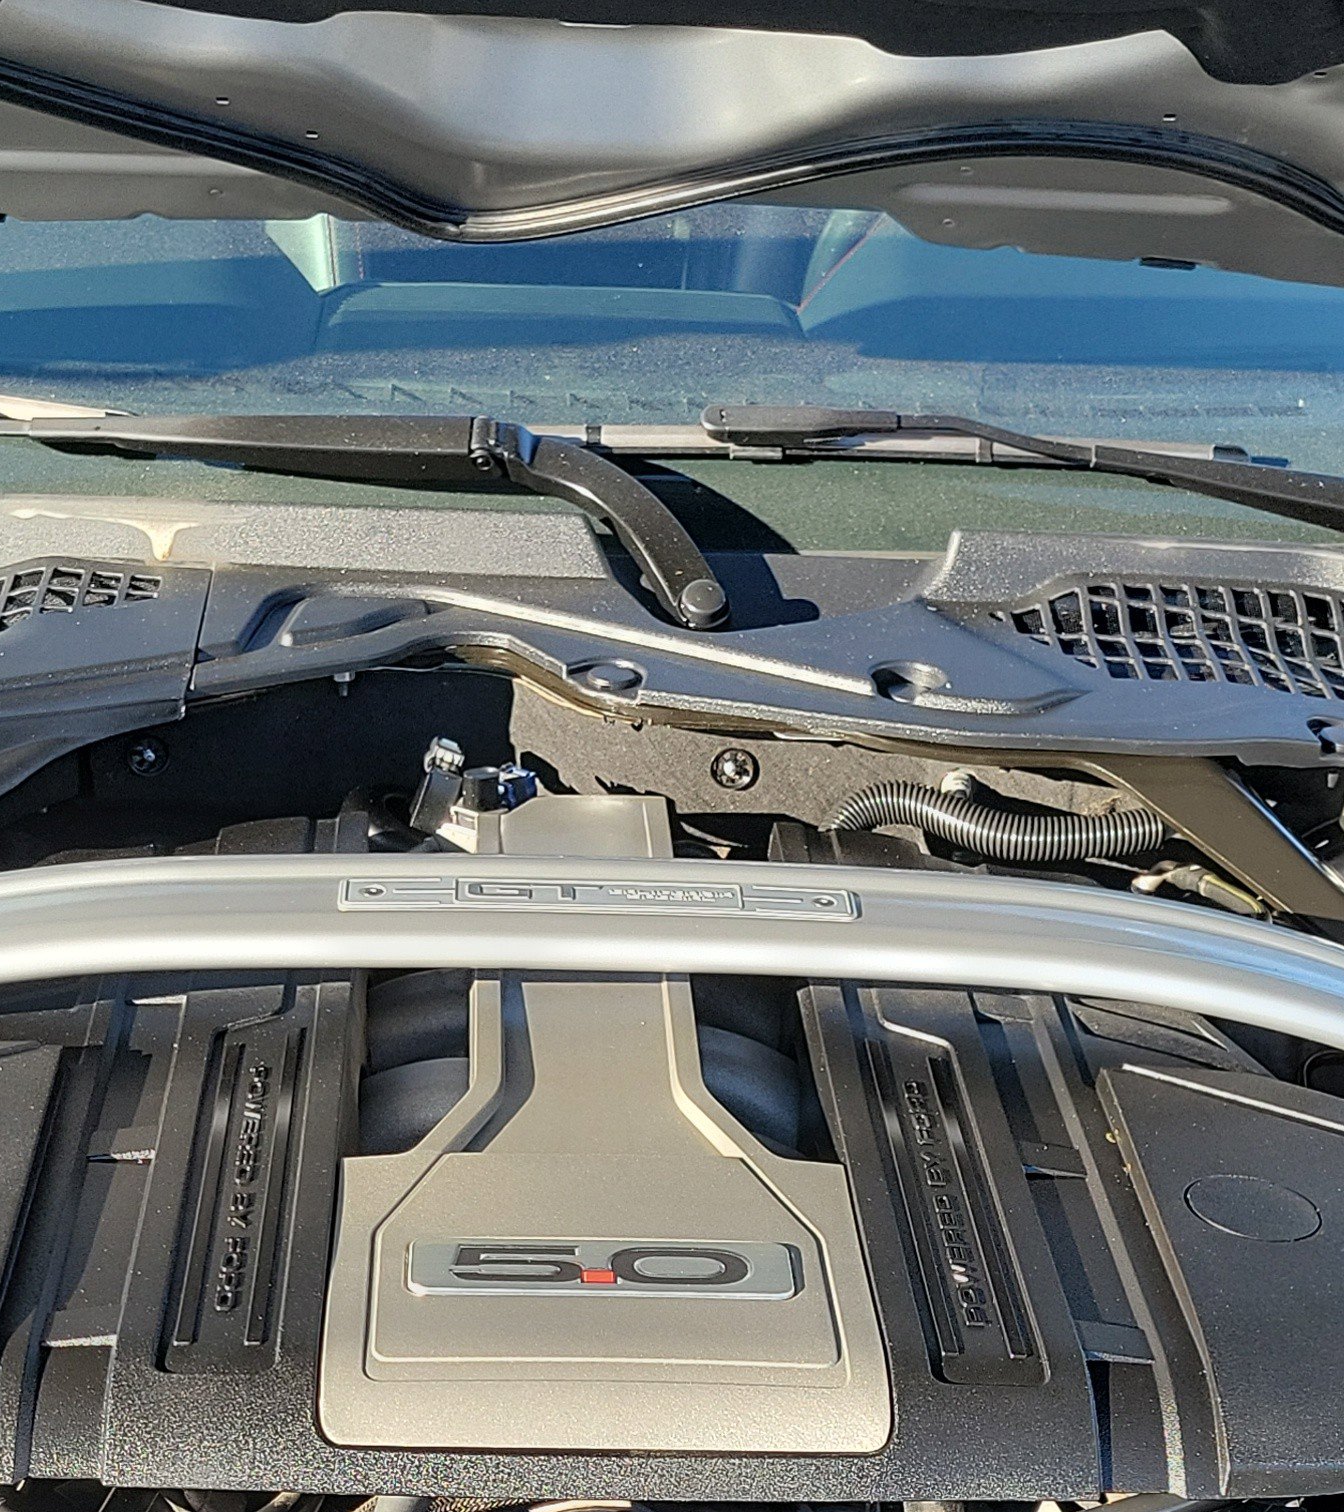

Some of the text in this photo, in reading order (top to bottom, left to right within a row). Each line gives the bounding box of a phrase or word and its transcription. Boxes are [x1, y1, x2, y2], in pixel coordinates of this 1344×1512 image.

[465, 882, 604, 901] GT
[214, 1062, 269, 1313] POWERED BY FORD
[902, 1079, 988, 1328] POWERED BY FORD
[448, 1243, 754, 1286] 5.0
